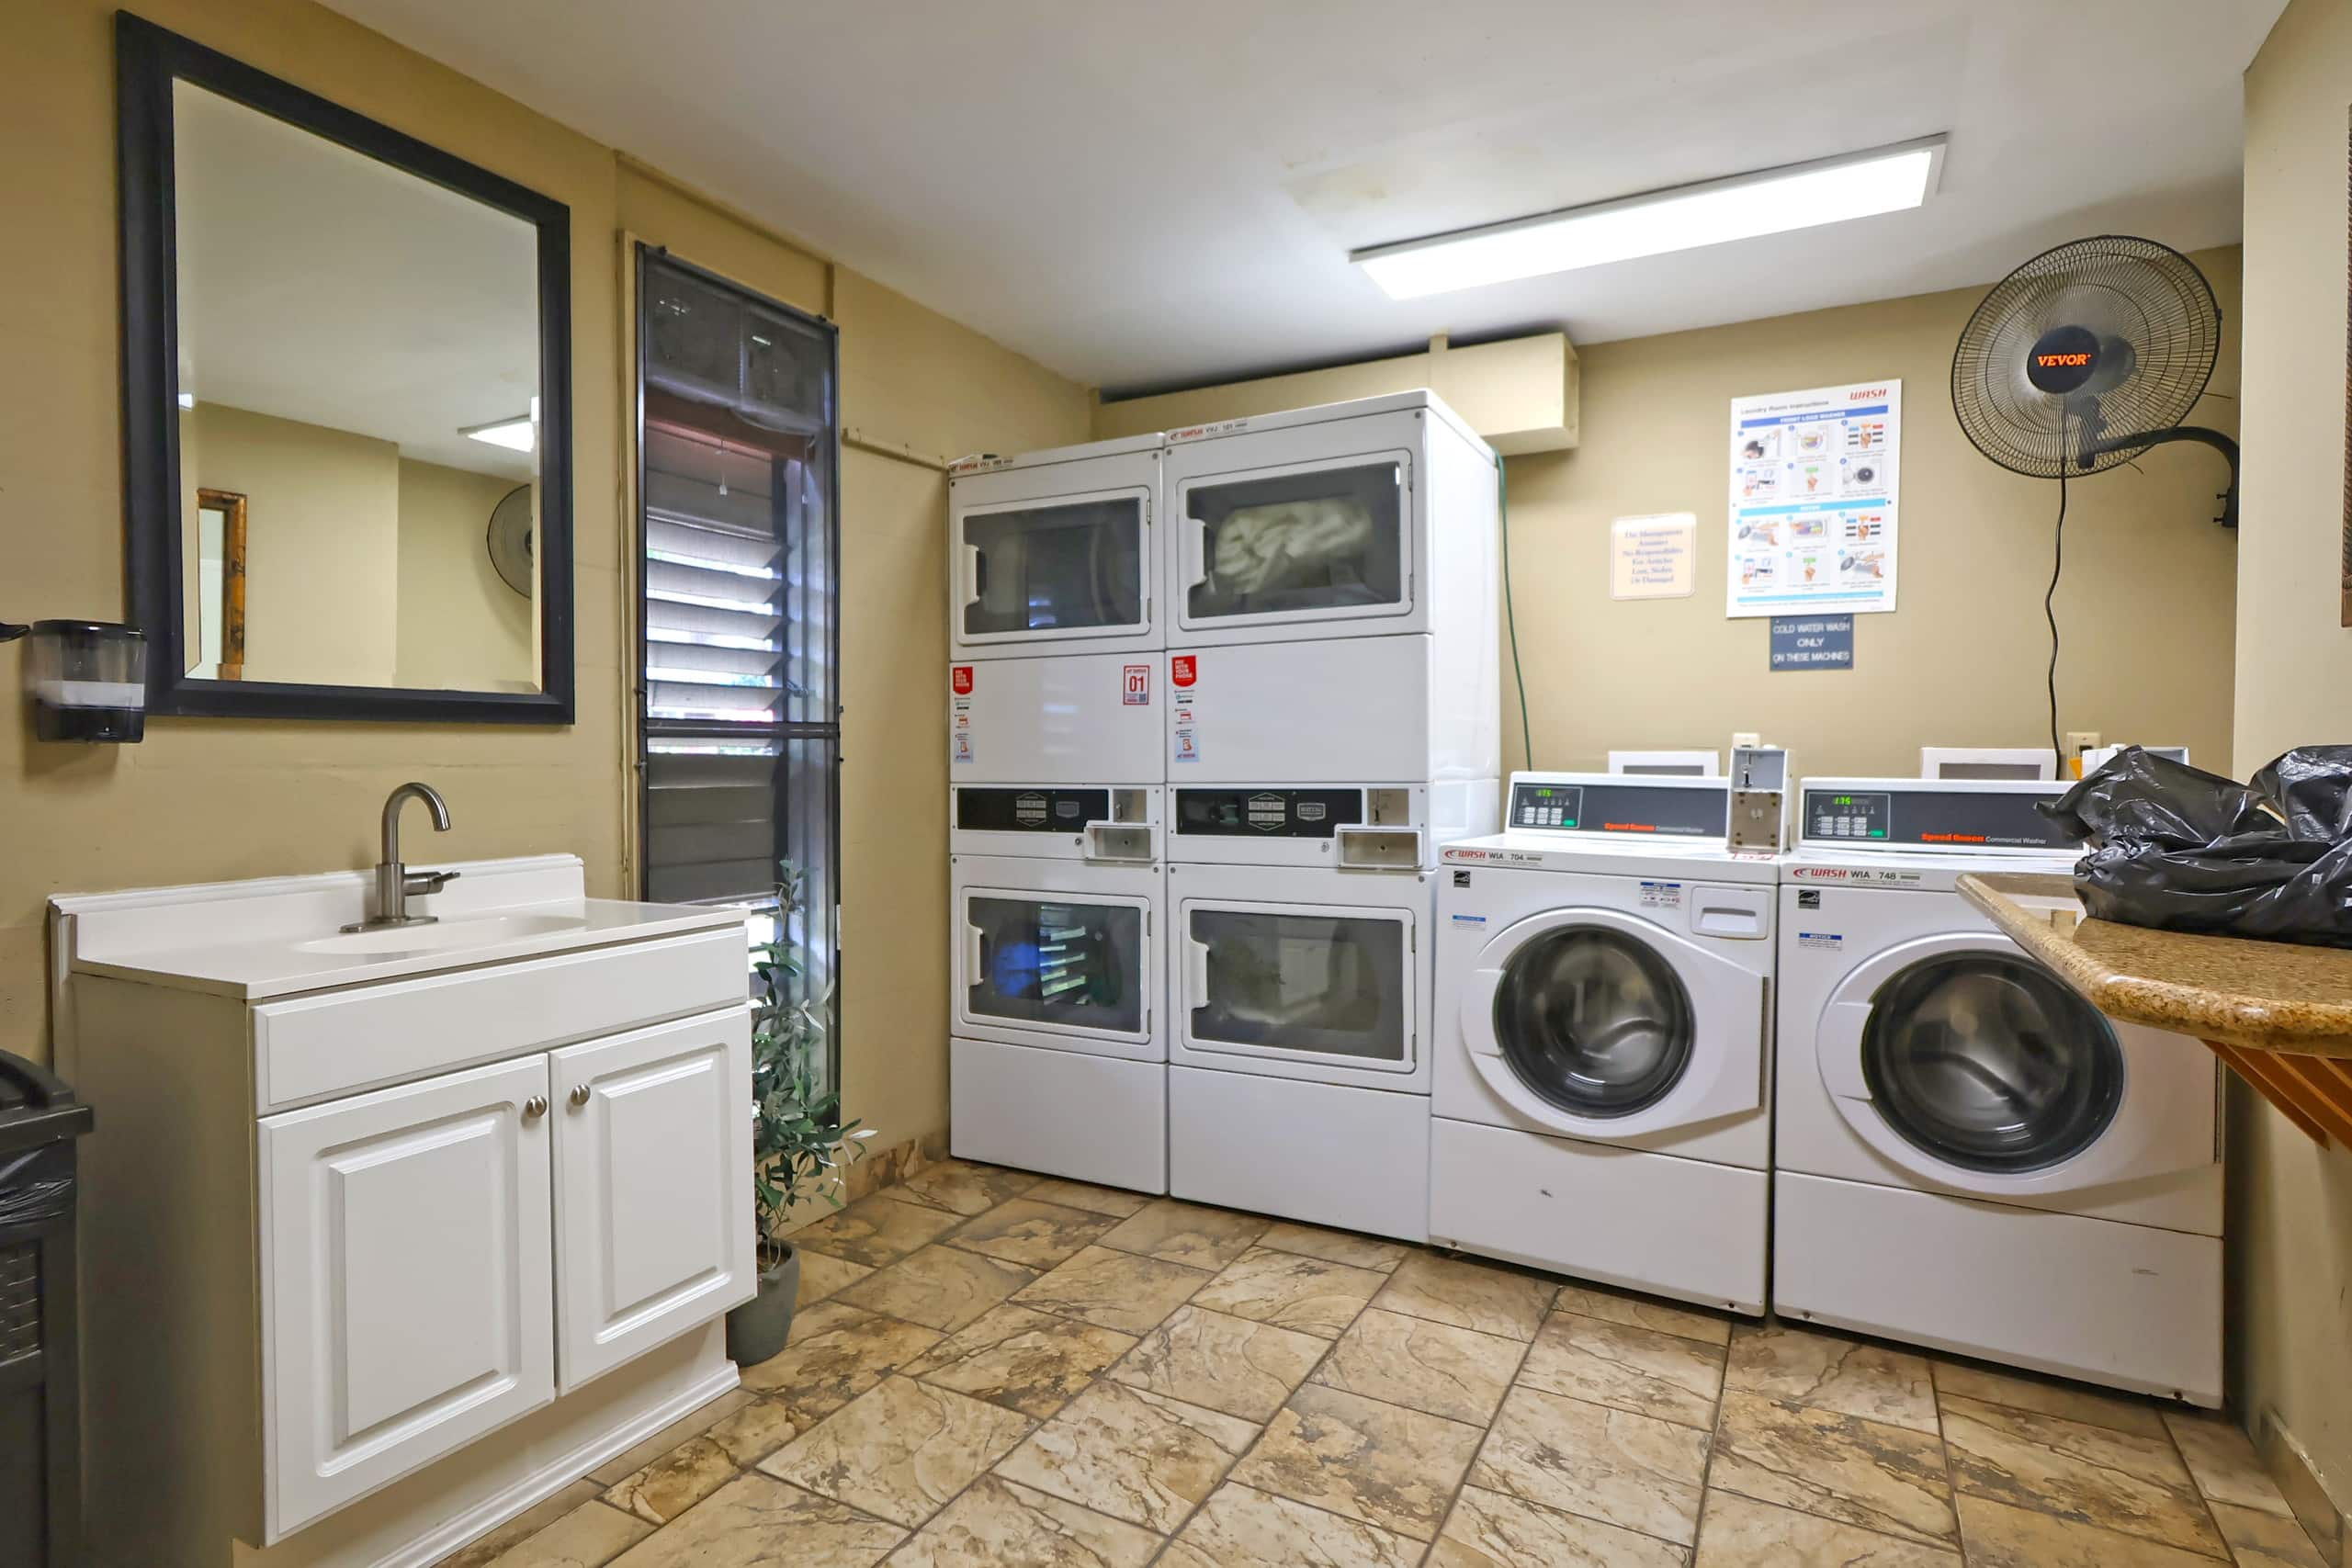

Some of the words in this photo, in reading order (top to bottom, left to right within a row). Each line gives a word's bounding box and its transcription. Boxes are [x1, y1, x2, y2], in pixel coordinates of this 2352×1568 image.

[2038, 354, 2088, 367] VEVOR
[1849, 389, 1887, 400] WASH
[1773, 624, 1795, 634] COLD
[1797, 623, 1824, 633] WATER
[1826, 622, 1850, 632] WASH
[1797, 637, 1825, 648] ONLY
[1773, 653, 1784, 661] ON
[1786, 652, 1810, 661] THESE
[1811, 651, 1850, 661] MACHINES
[1129, 676, 1144, 692] 01
[1921, 832, 1952, 841] Speed
[1953, 833, 1984, 842] Queen
[1458, 851, 1486, 859] WASH
[1811, 868, 1847, 878] WASH
[1850, 871, 1871, 879] WIA
[1879, 872, 1896, 880] 748
